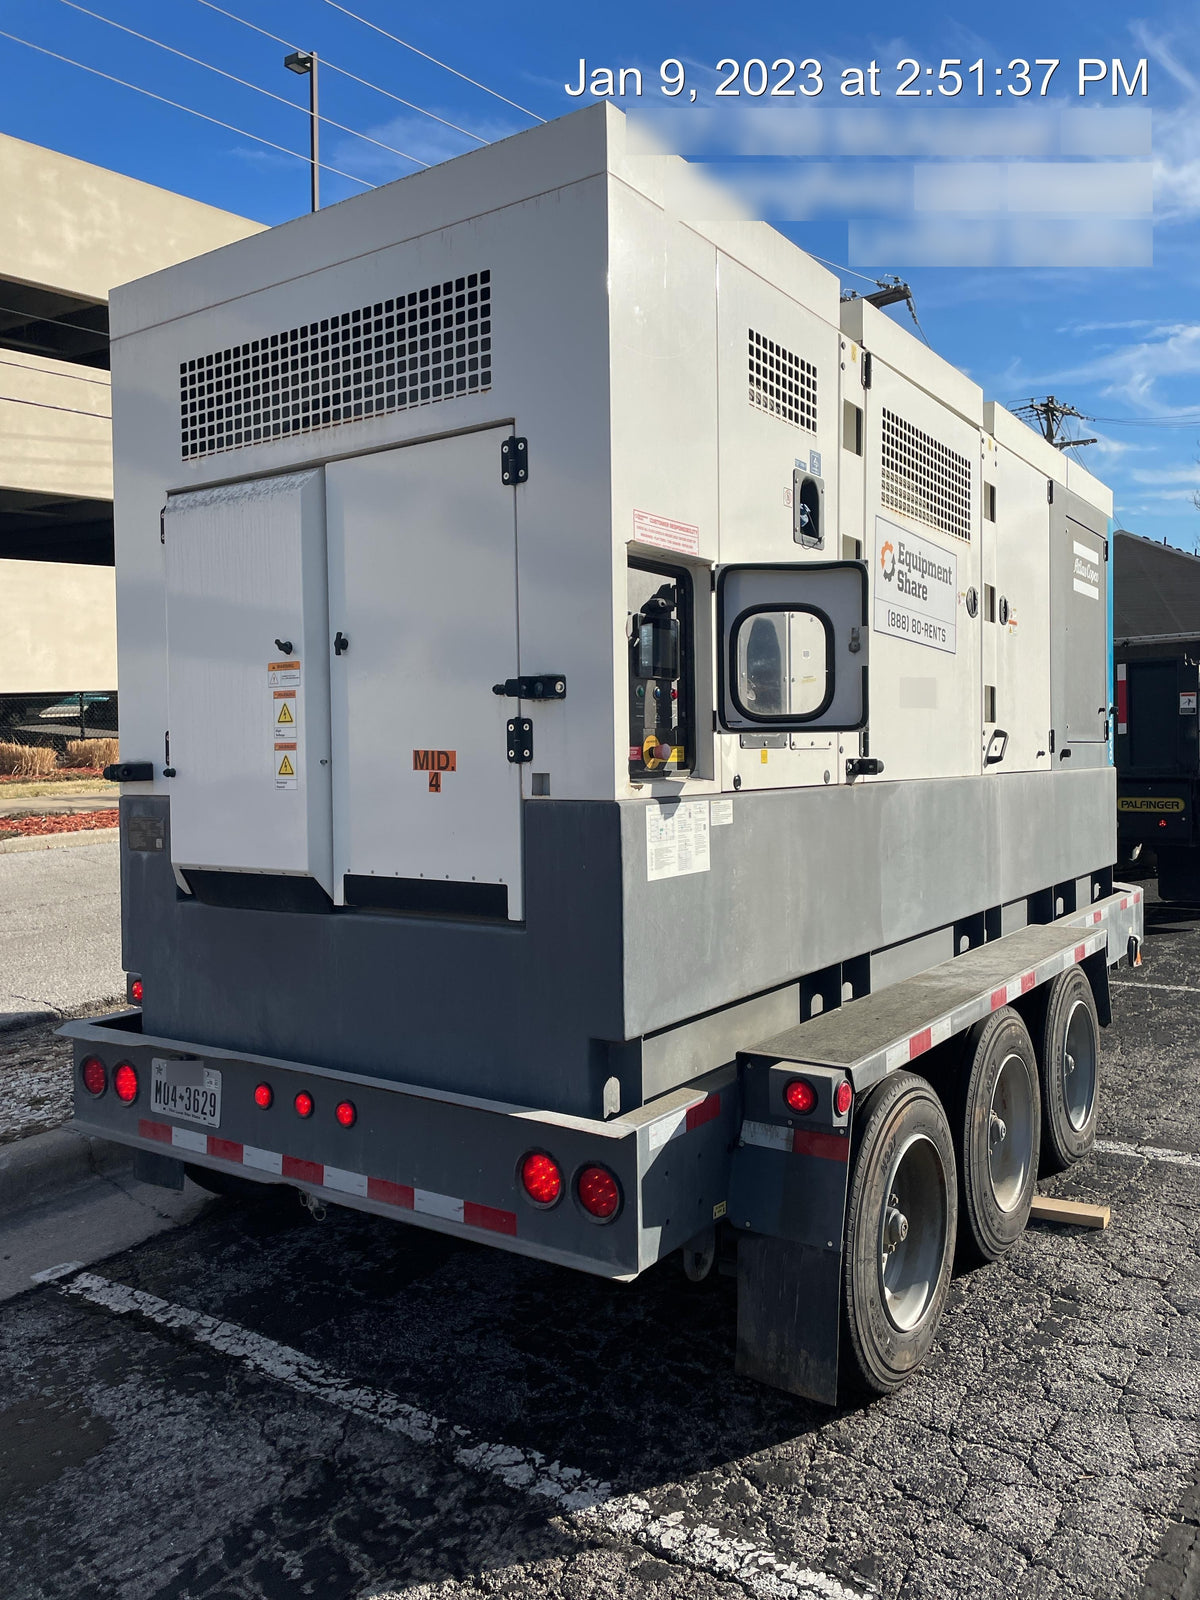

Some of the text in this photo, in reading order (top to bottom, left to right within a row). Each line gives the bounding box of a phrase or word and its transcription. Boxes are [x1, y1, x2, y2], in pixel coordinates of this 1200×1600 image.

[897, 541, 952, 586] Equipment
[897, 569, 928, 601] Share
[887, 608, 909, 632] (888)
[414, 750, 455, 771] MID.
[429, 772, 441, 792] 4
[1121, 800, 1180, 810] PALFINGER
